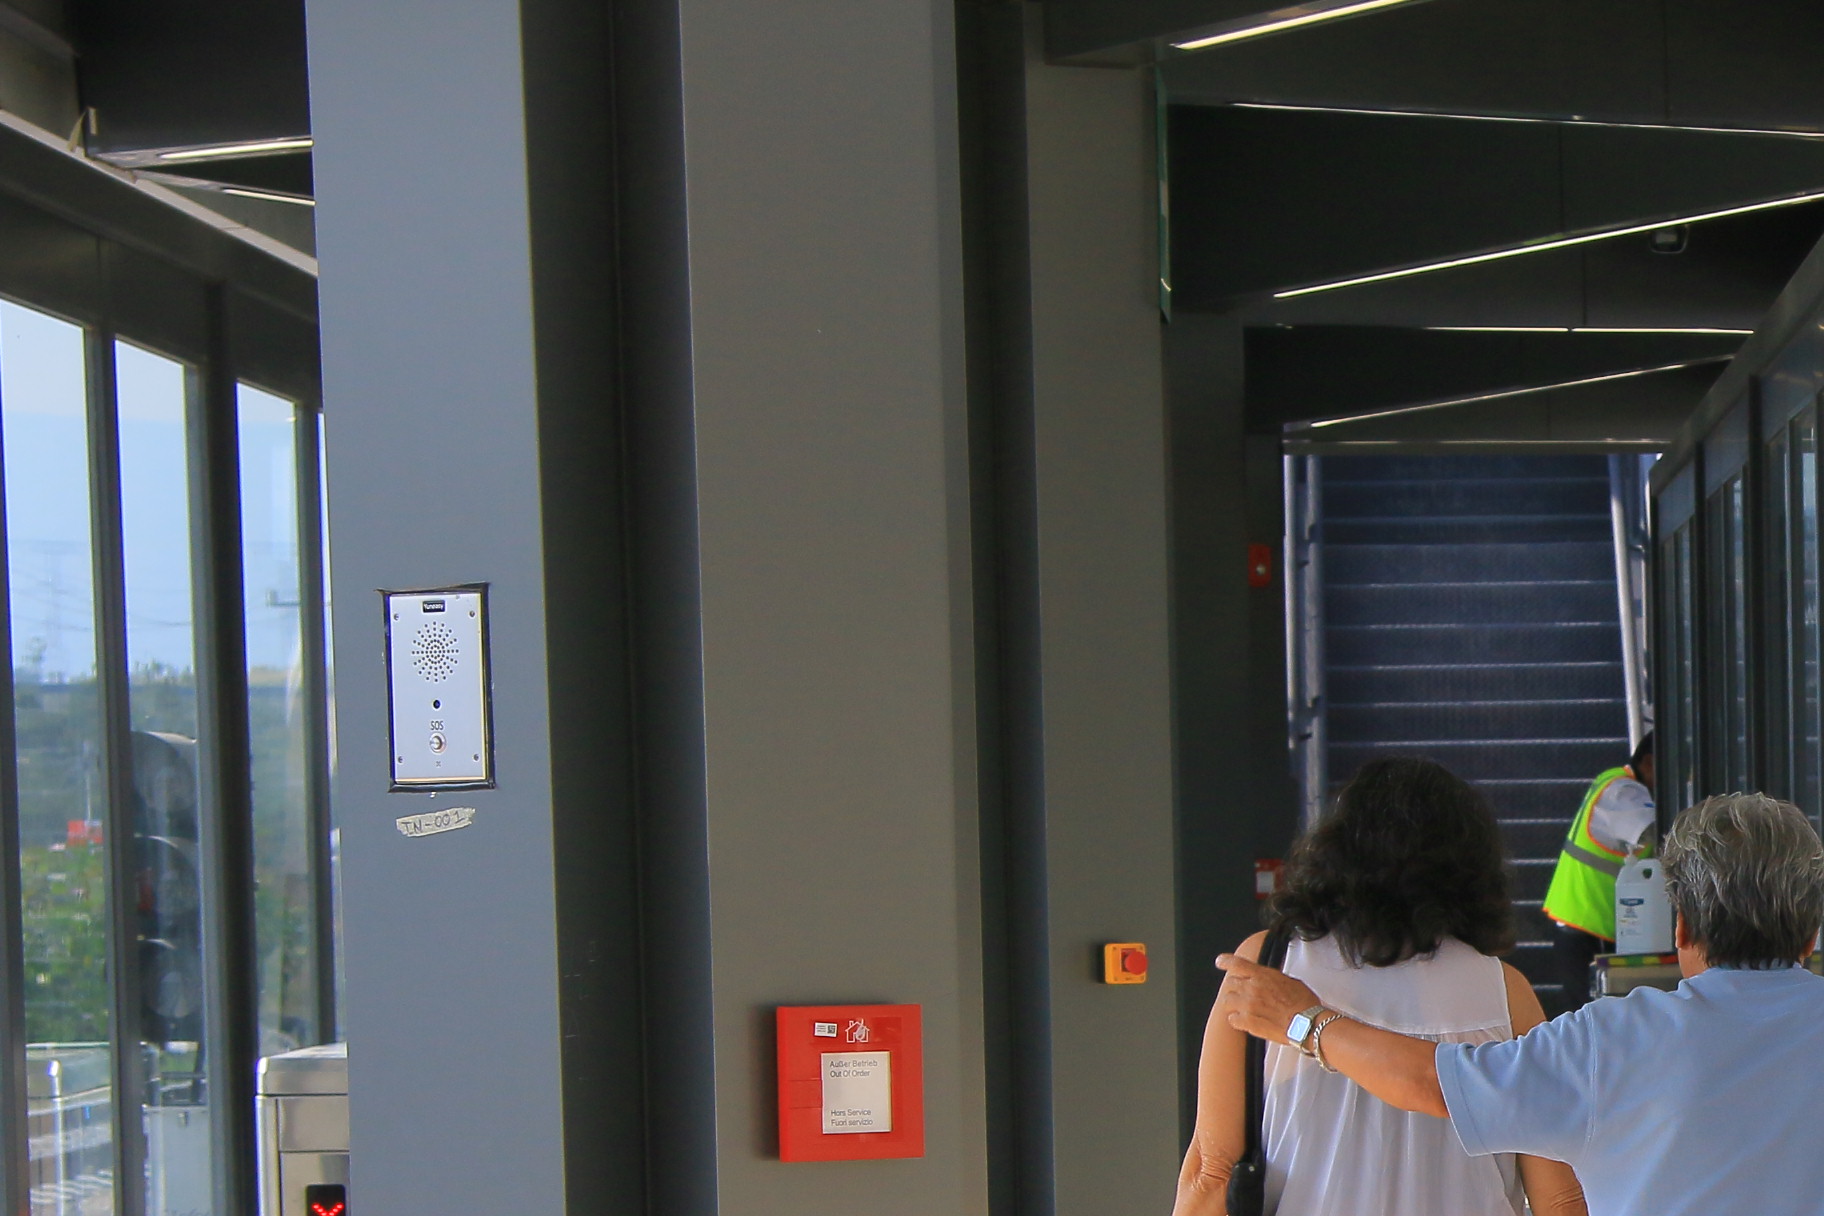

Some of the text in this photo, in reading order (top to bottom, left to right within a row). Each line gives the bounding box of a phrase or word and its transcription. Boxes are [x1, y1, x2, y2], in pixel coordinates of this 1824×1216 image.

[430, 720, 444, 730] SOS
[852, 1059, 878, 1067] Betrieb
[830, 1070, 842, 1078] Out
[852, 1069, 870, 1077] Order
[831, 1108, 872, 1117] Hors Service
